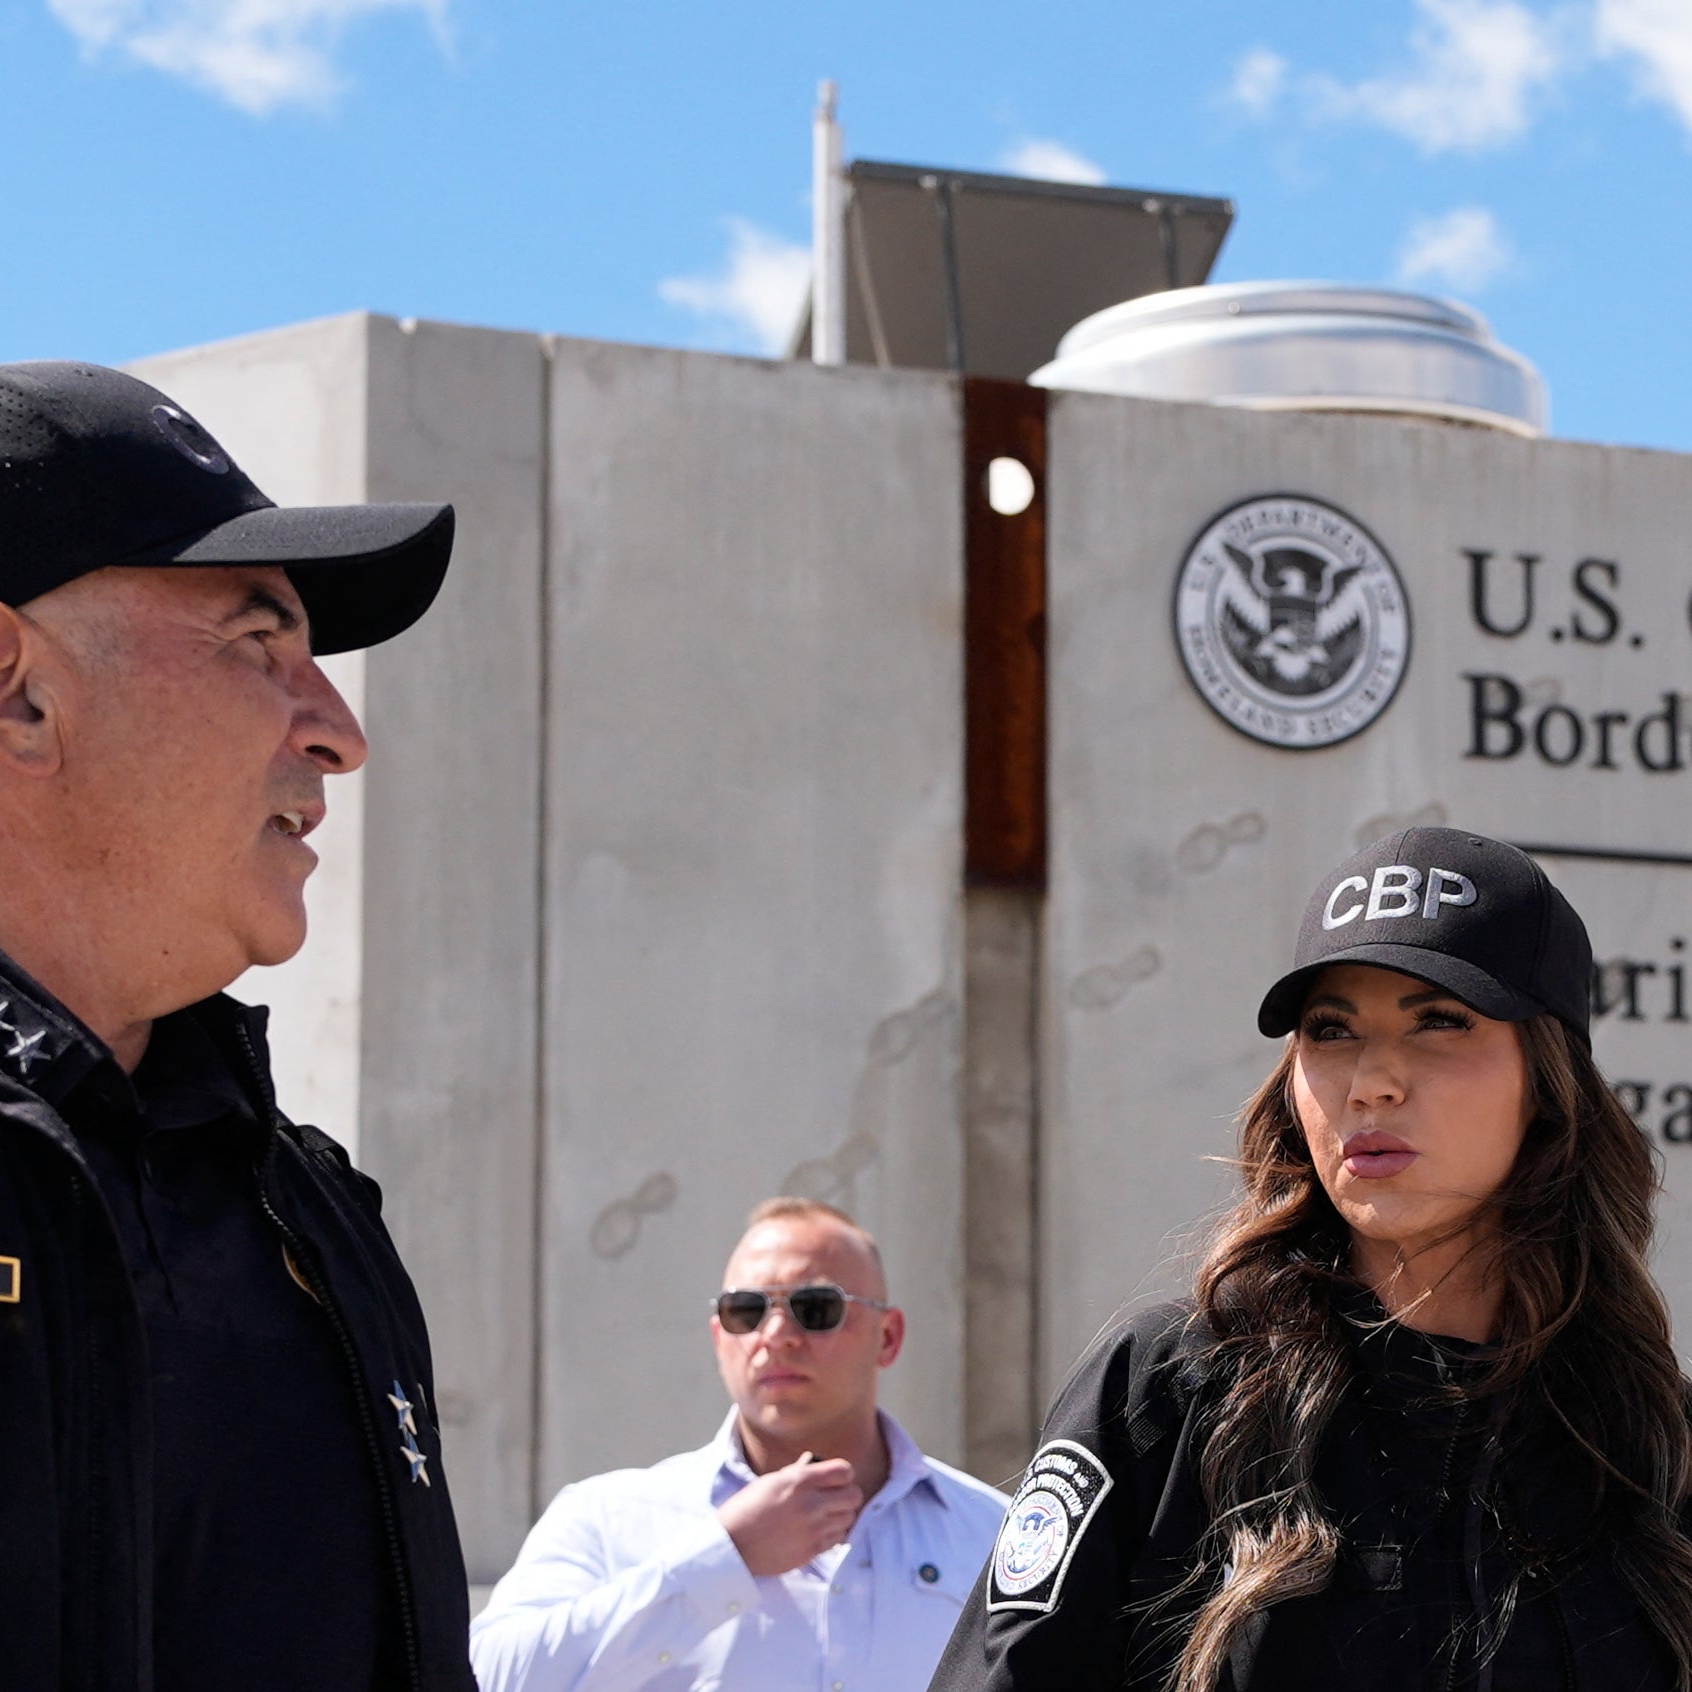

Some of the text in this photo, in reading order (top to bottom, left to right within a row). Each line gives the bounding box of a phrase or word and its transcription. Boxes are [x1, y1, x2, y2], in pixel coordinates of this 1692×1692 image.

[1461, 549, 1645, 648] U.S.
[1322, 864, 1478, 931] CBP
[1034, 1454, 1079, 1476] CUSTOMS
[1037, 1472, 1084, 1517] PROTECTION
